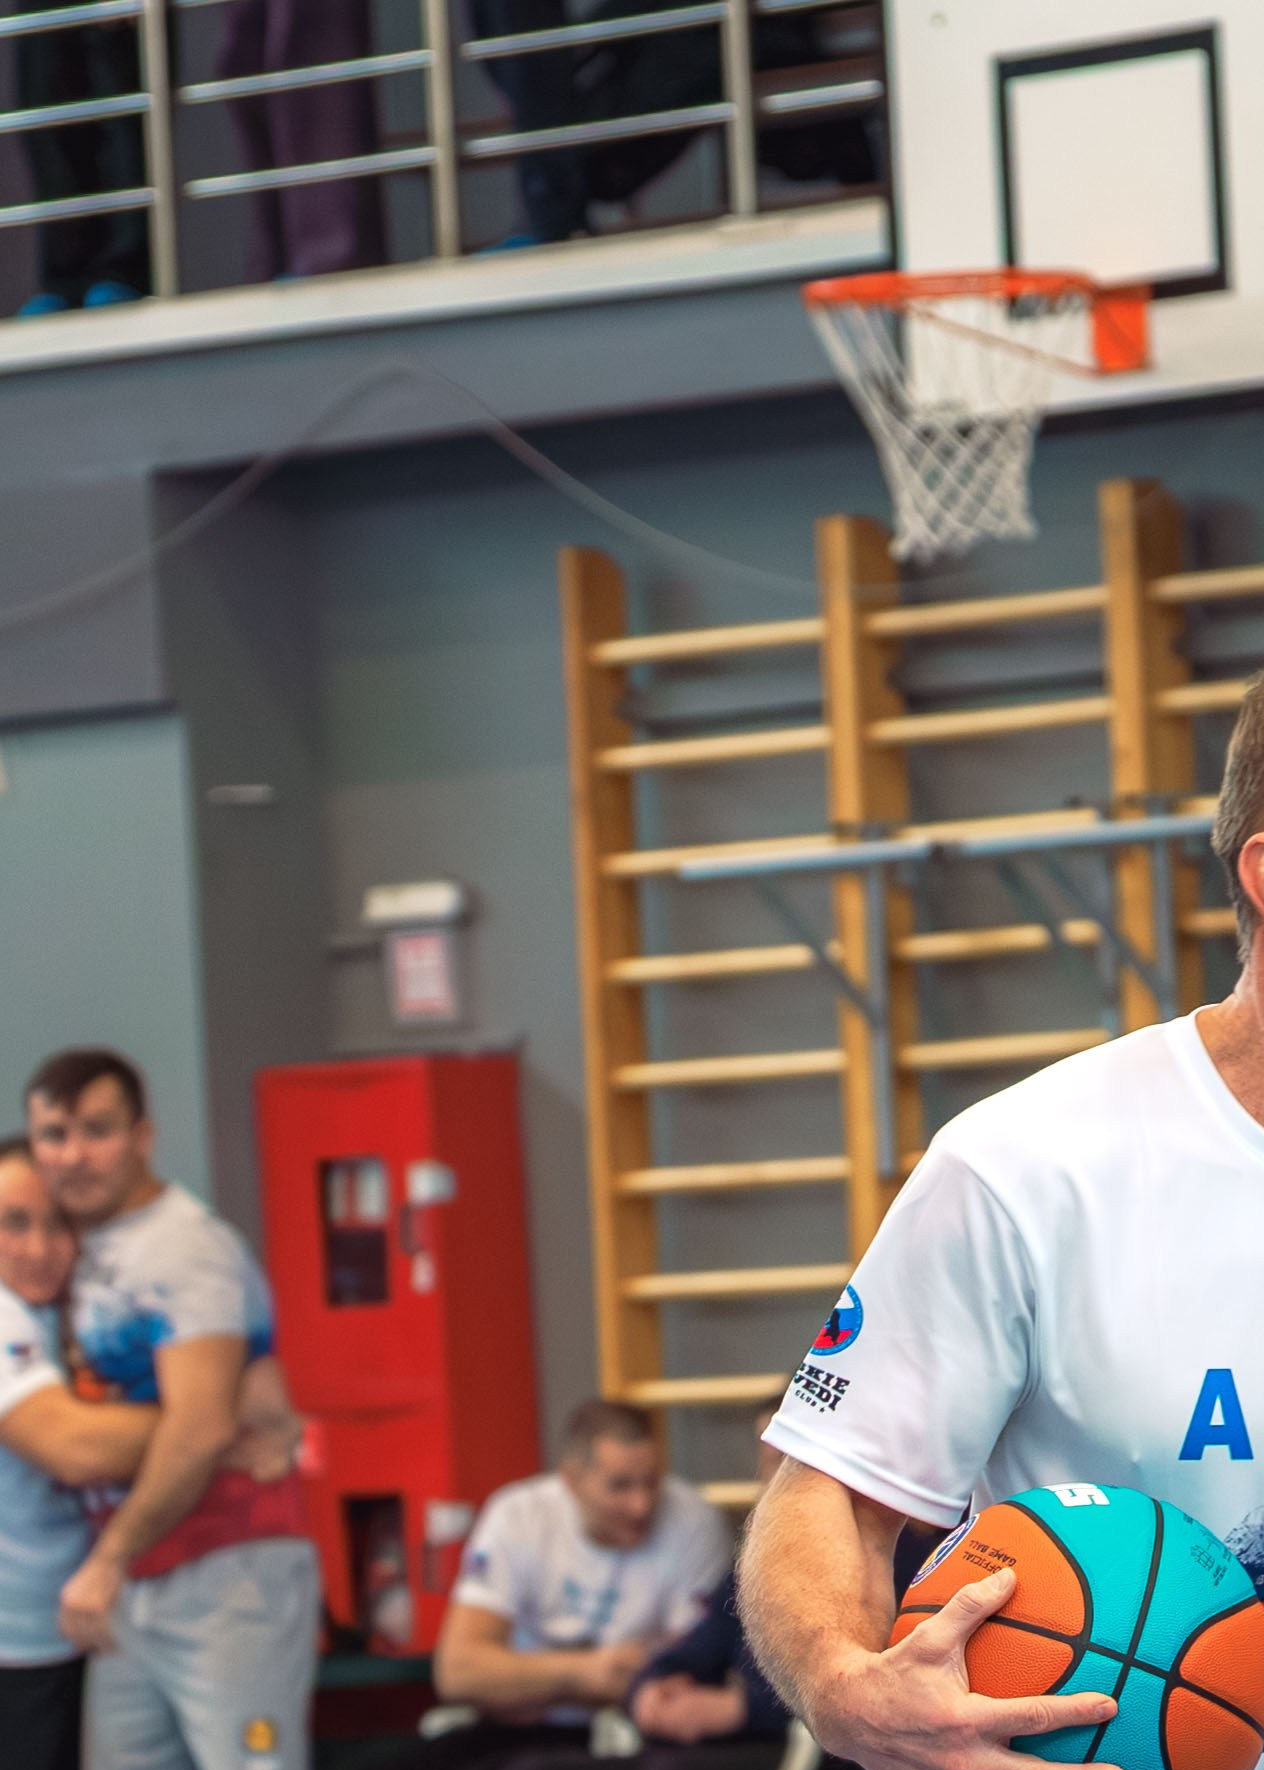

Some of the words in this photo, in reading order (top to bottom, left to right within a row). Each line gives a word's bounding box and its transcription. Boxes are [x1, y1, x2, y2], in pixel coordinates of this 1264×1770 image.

[969, 1540, 989, 1553] BALL
[962, 1551, 1002, 1574] OFFICIAL
[989, 1547, 1017, 1567] GAME
